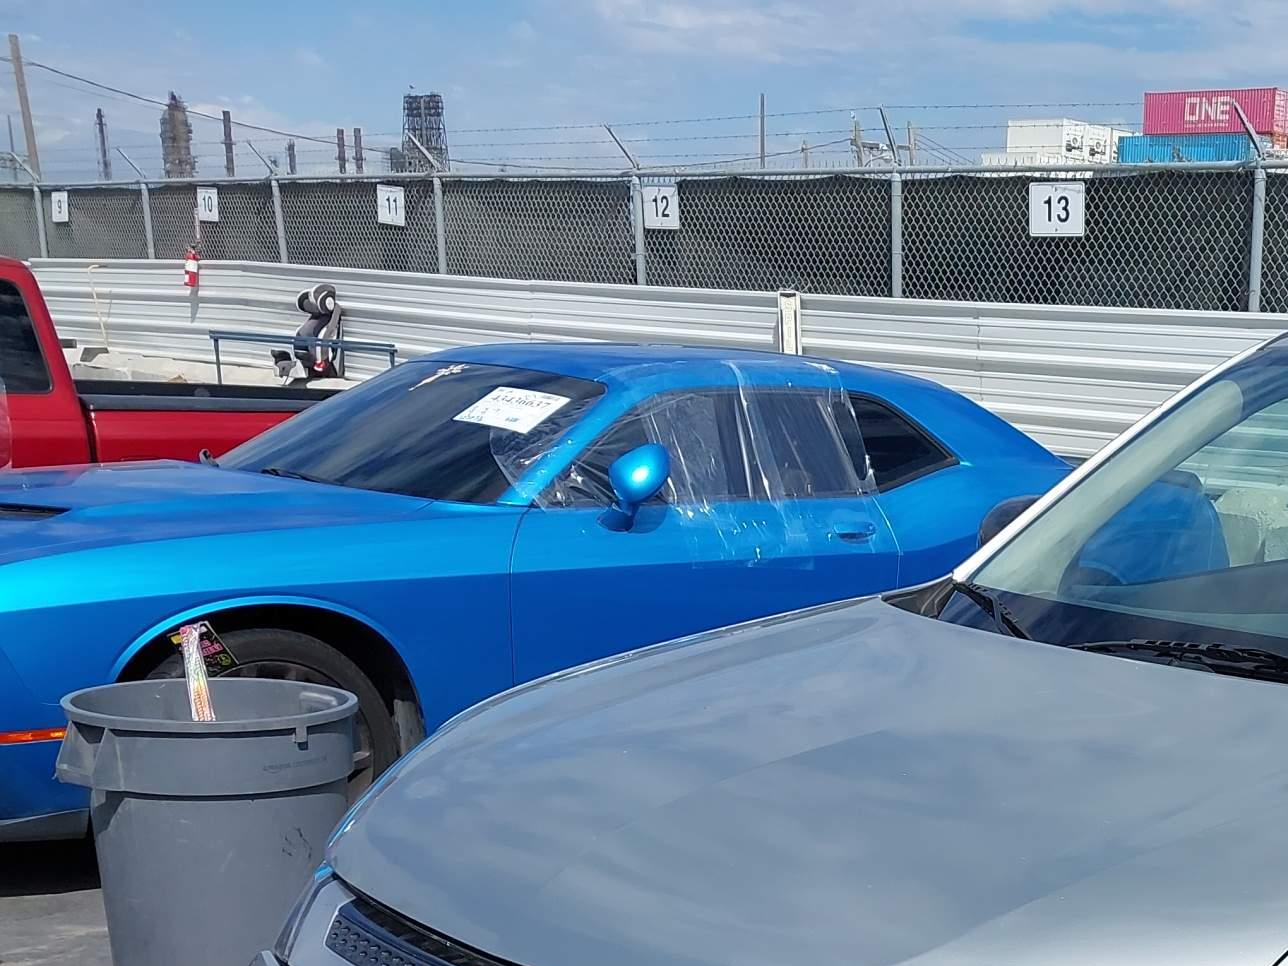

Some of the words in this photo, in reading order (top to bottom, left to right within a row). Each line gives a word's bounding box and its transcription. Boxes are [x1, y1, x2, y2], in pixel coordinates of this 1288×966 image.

[1184, 96, 1230, 121] ONE
[57, 199, 63, 214] 9
[202, 194, 213, 213] 10
[385, 195, 398, 217] 11
[652, 195, 670, 218] 12
[1043, 195, 1070, 223] 13
